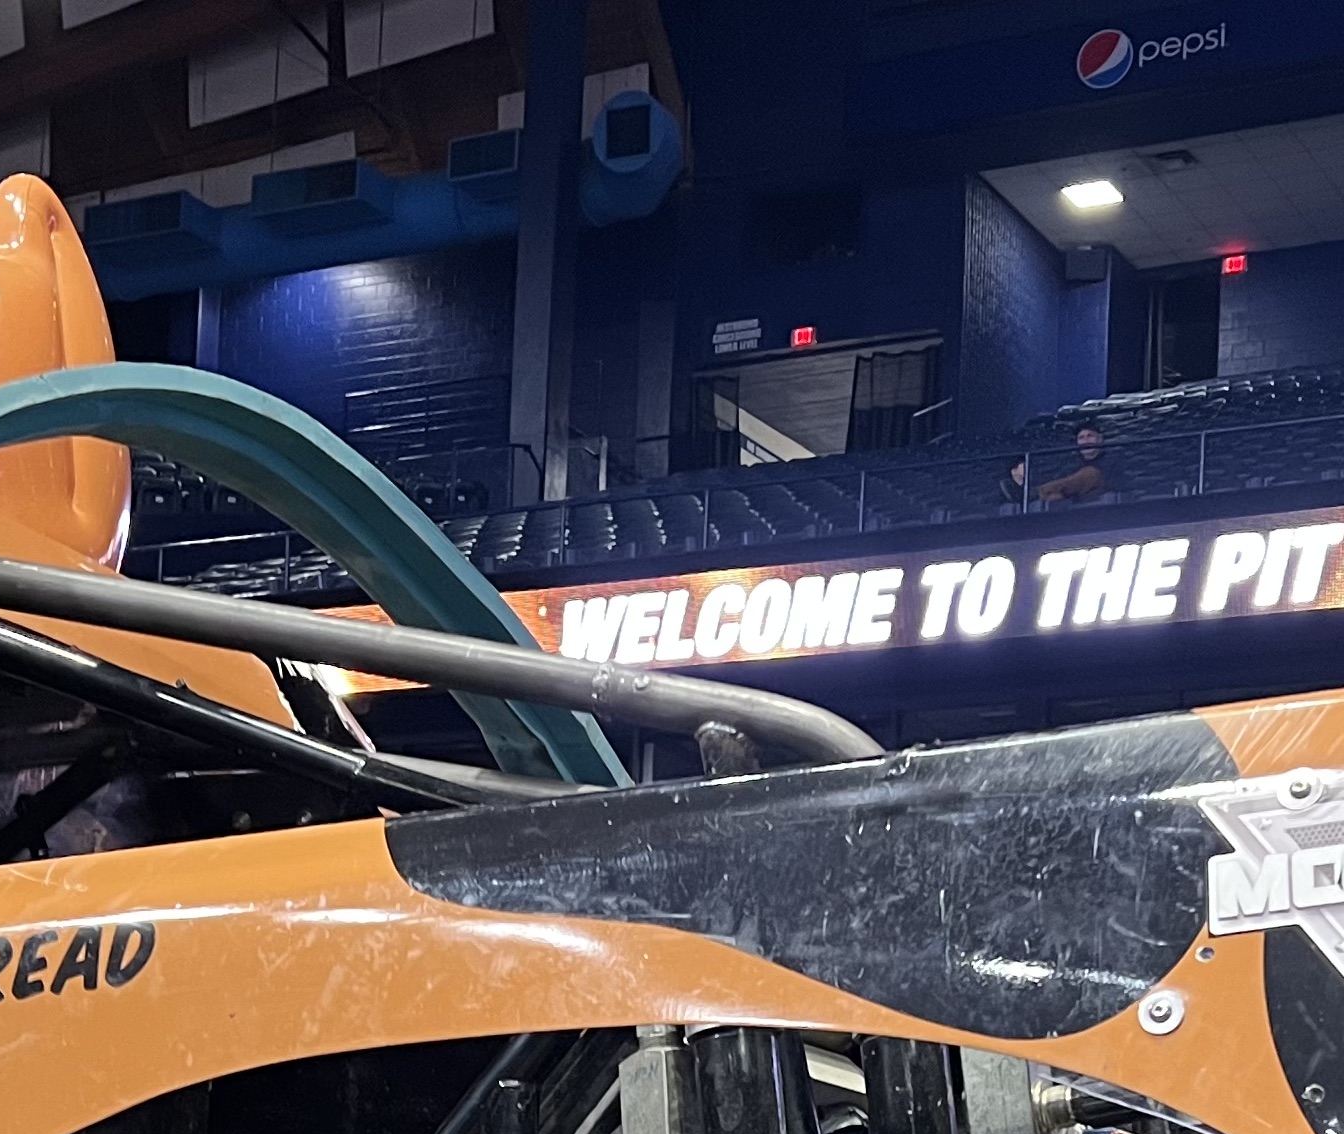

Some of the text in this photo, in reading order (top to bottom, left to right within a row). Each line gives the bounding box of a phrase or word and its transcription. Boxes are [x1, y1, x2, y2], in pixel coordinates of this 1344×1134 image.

[1138, 22, 1226, 68] pepsi
[558, 566, 905, 664] WELCOME
[919, 554, 1016, 640] TO
[1038, 537, 1192, 629] THE
